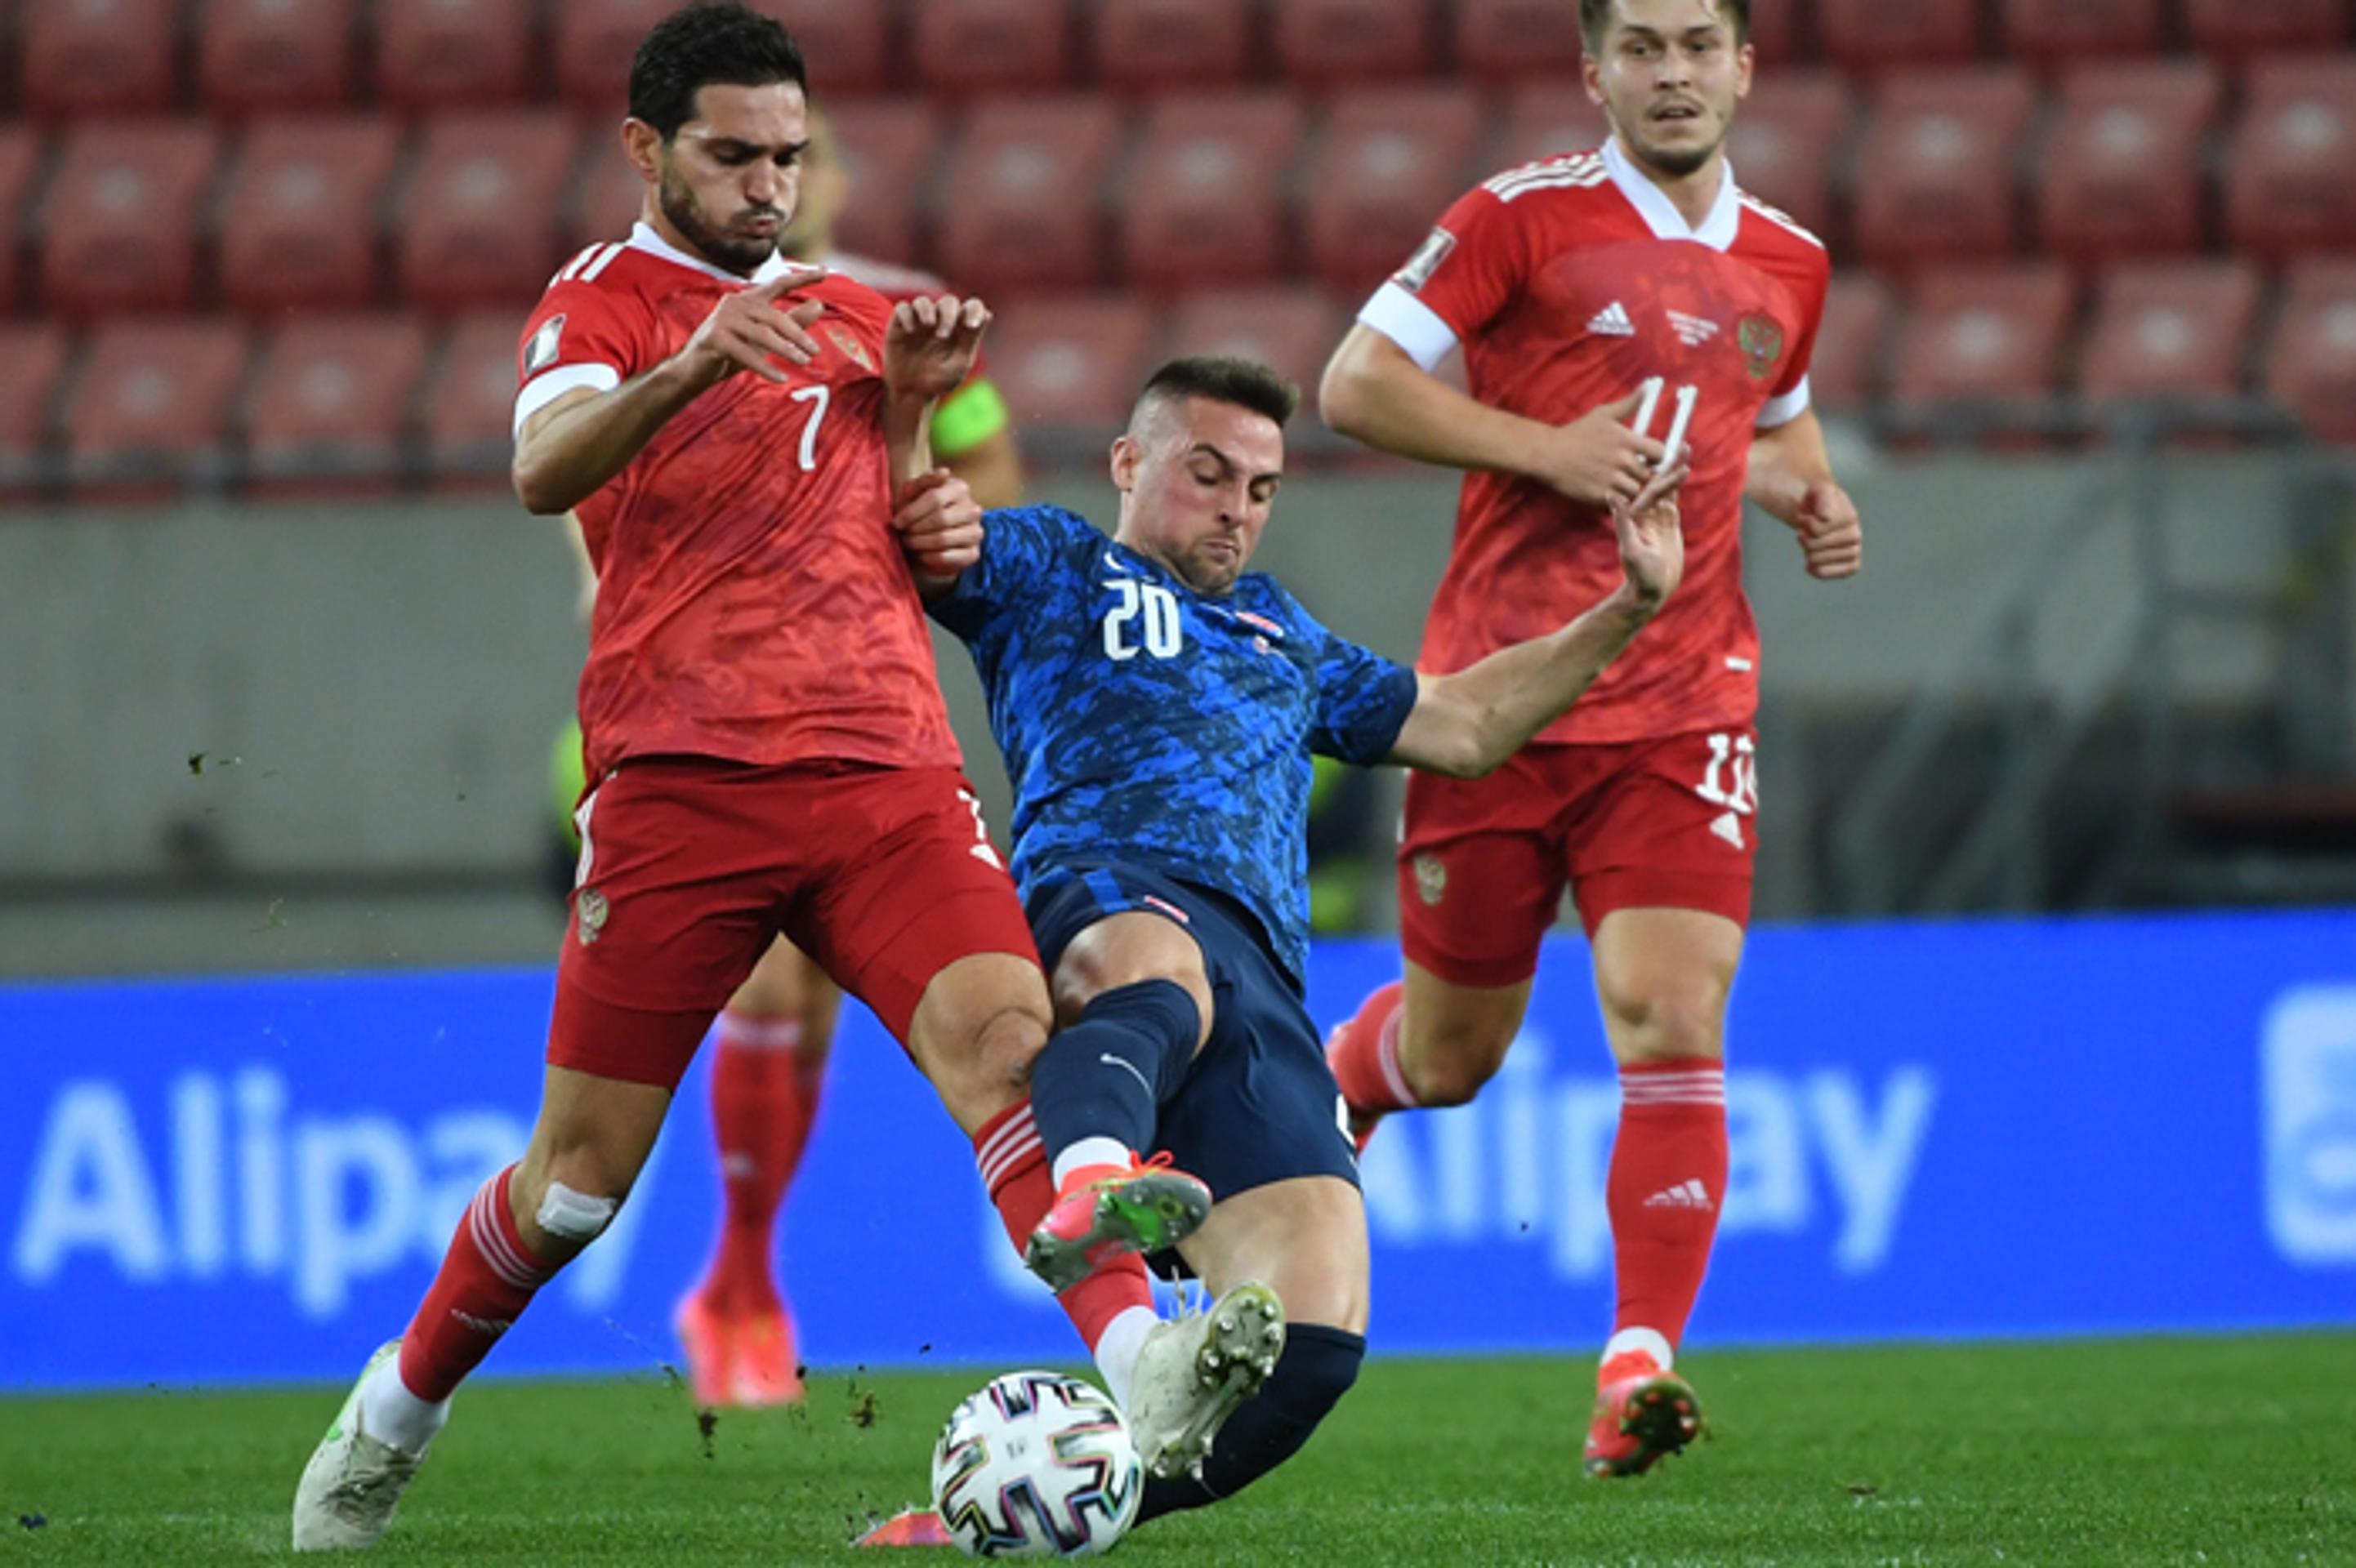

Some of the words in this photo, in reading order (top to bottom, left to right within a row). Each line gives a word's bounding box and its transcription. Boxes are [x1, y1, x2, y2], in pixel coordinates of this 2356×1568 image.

[790, 384, 830, 471] 7
[1633, 375, 1698, 475] 11
[1102, 579, 1182, 660] 20
